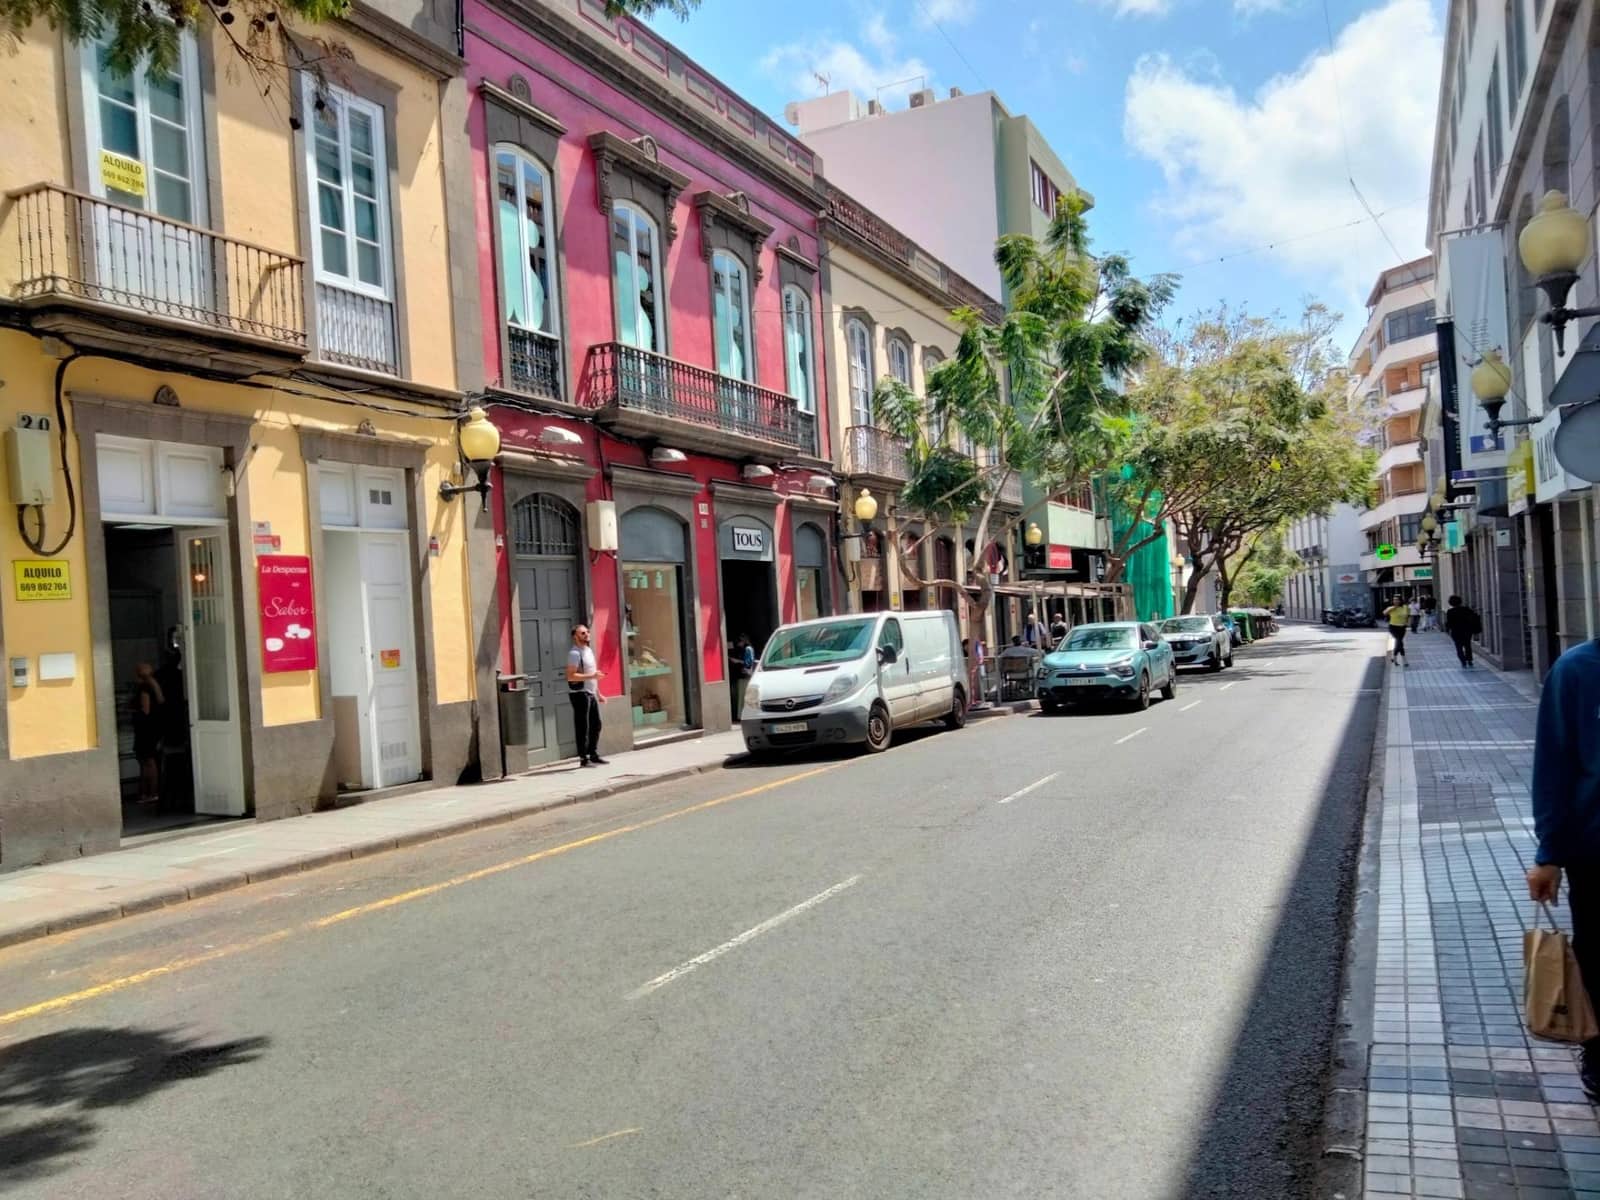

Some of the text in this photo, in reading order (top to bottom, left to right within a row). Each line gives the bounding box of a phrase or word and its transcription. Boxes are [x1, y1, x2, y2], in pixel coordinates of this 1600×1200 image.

[103, 155, 142, 175] ALQUILO
[21, 415, 50, 431] 20
[735, 532, 762, 547] TOUS
[24, 567, 62, 579] ALQUILO
[264, 596, 310, 618] Sabor
